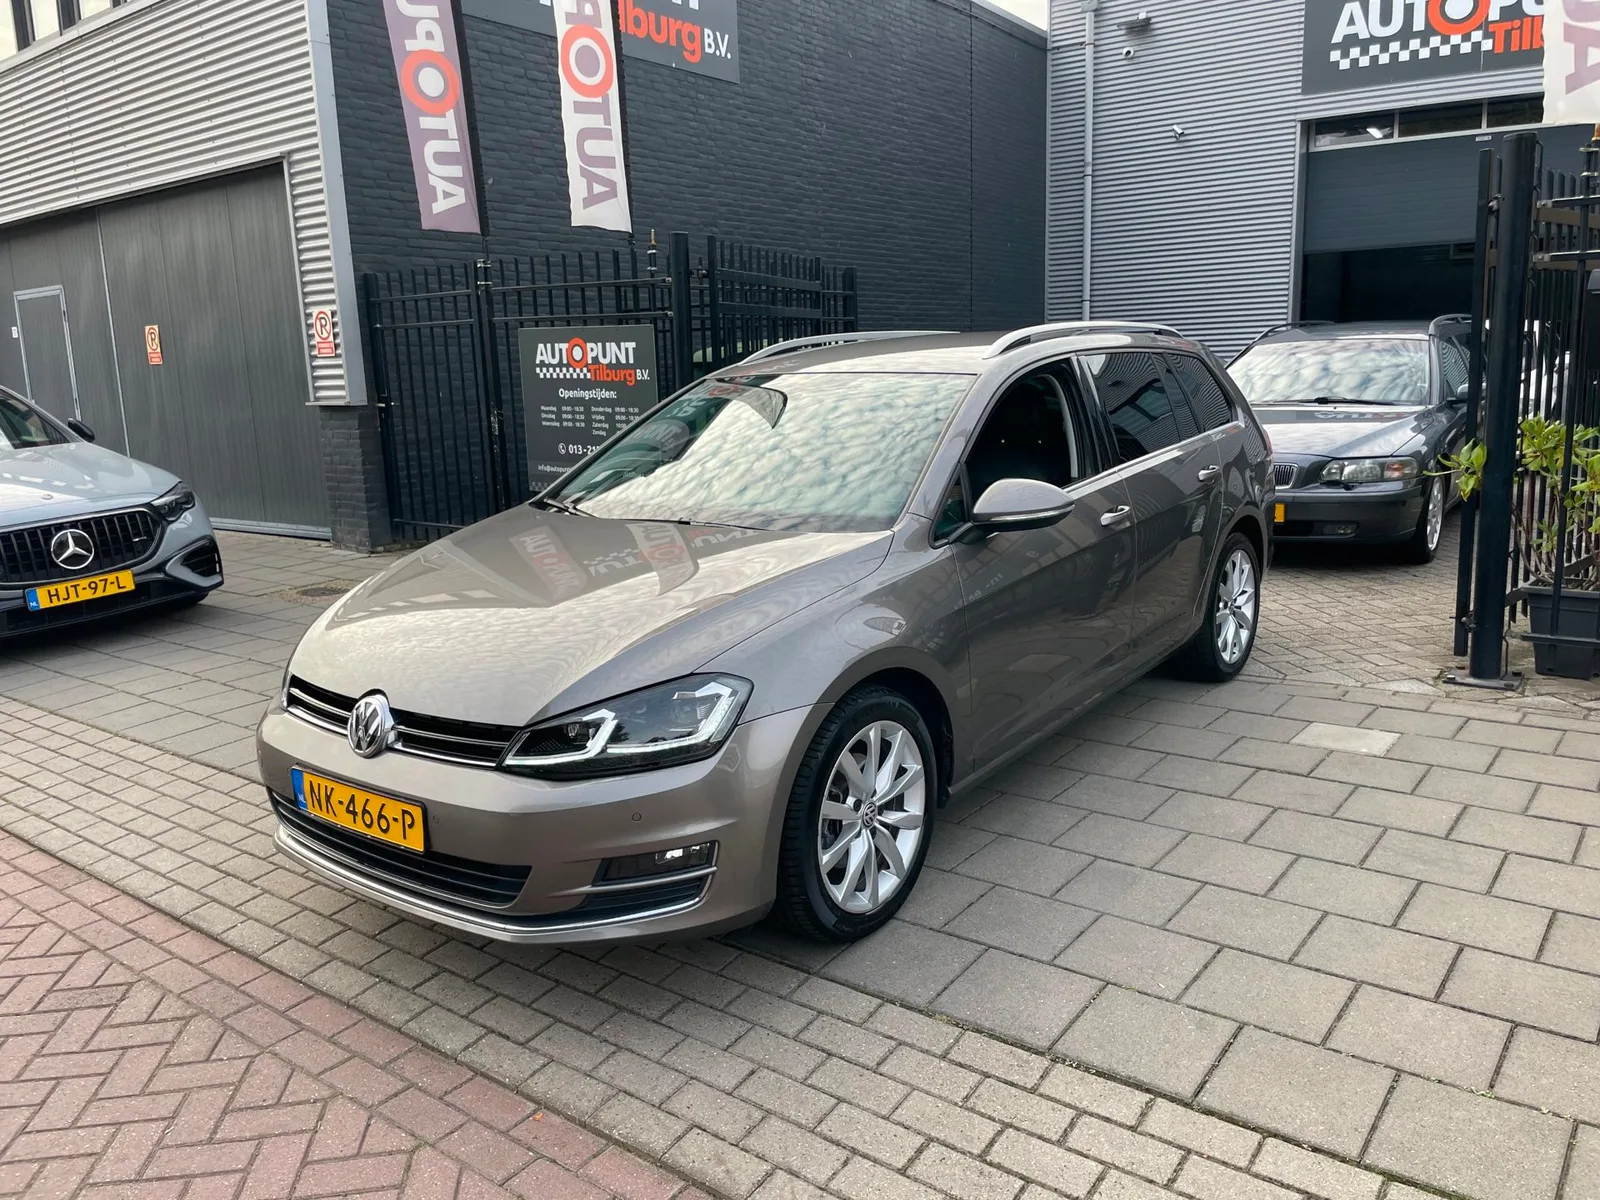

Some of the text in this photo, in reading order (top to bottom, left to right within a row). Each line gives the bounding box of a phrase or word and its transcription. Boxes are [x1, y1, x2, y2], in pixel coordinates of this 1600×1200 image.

[703, 27, 732, 60] B.V.
[535, 337, 637, 369] AUTOPUNT
[587, 364, 650, 386] Tilburg B.V.
[558, 388, 618, 400] Openingstijden:
[47, 575, 127, 604] HJT-97-L
[309, 779, 415, 840] NK-466-P
